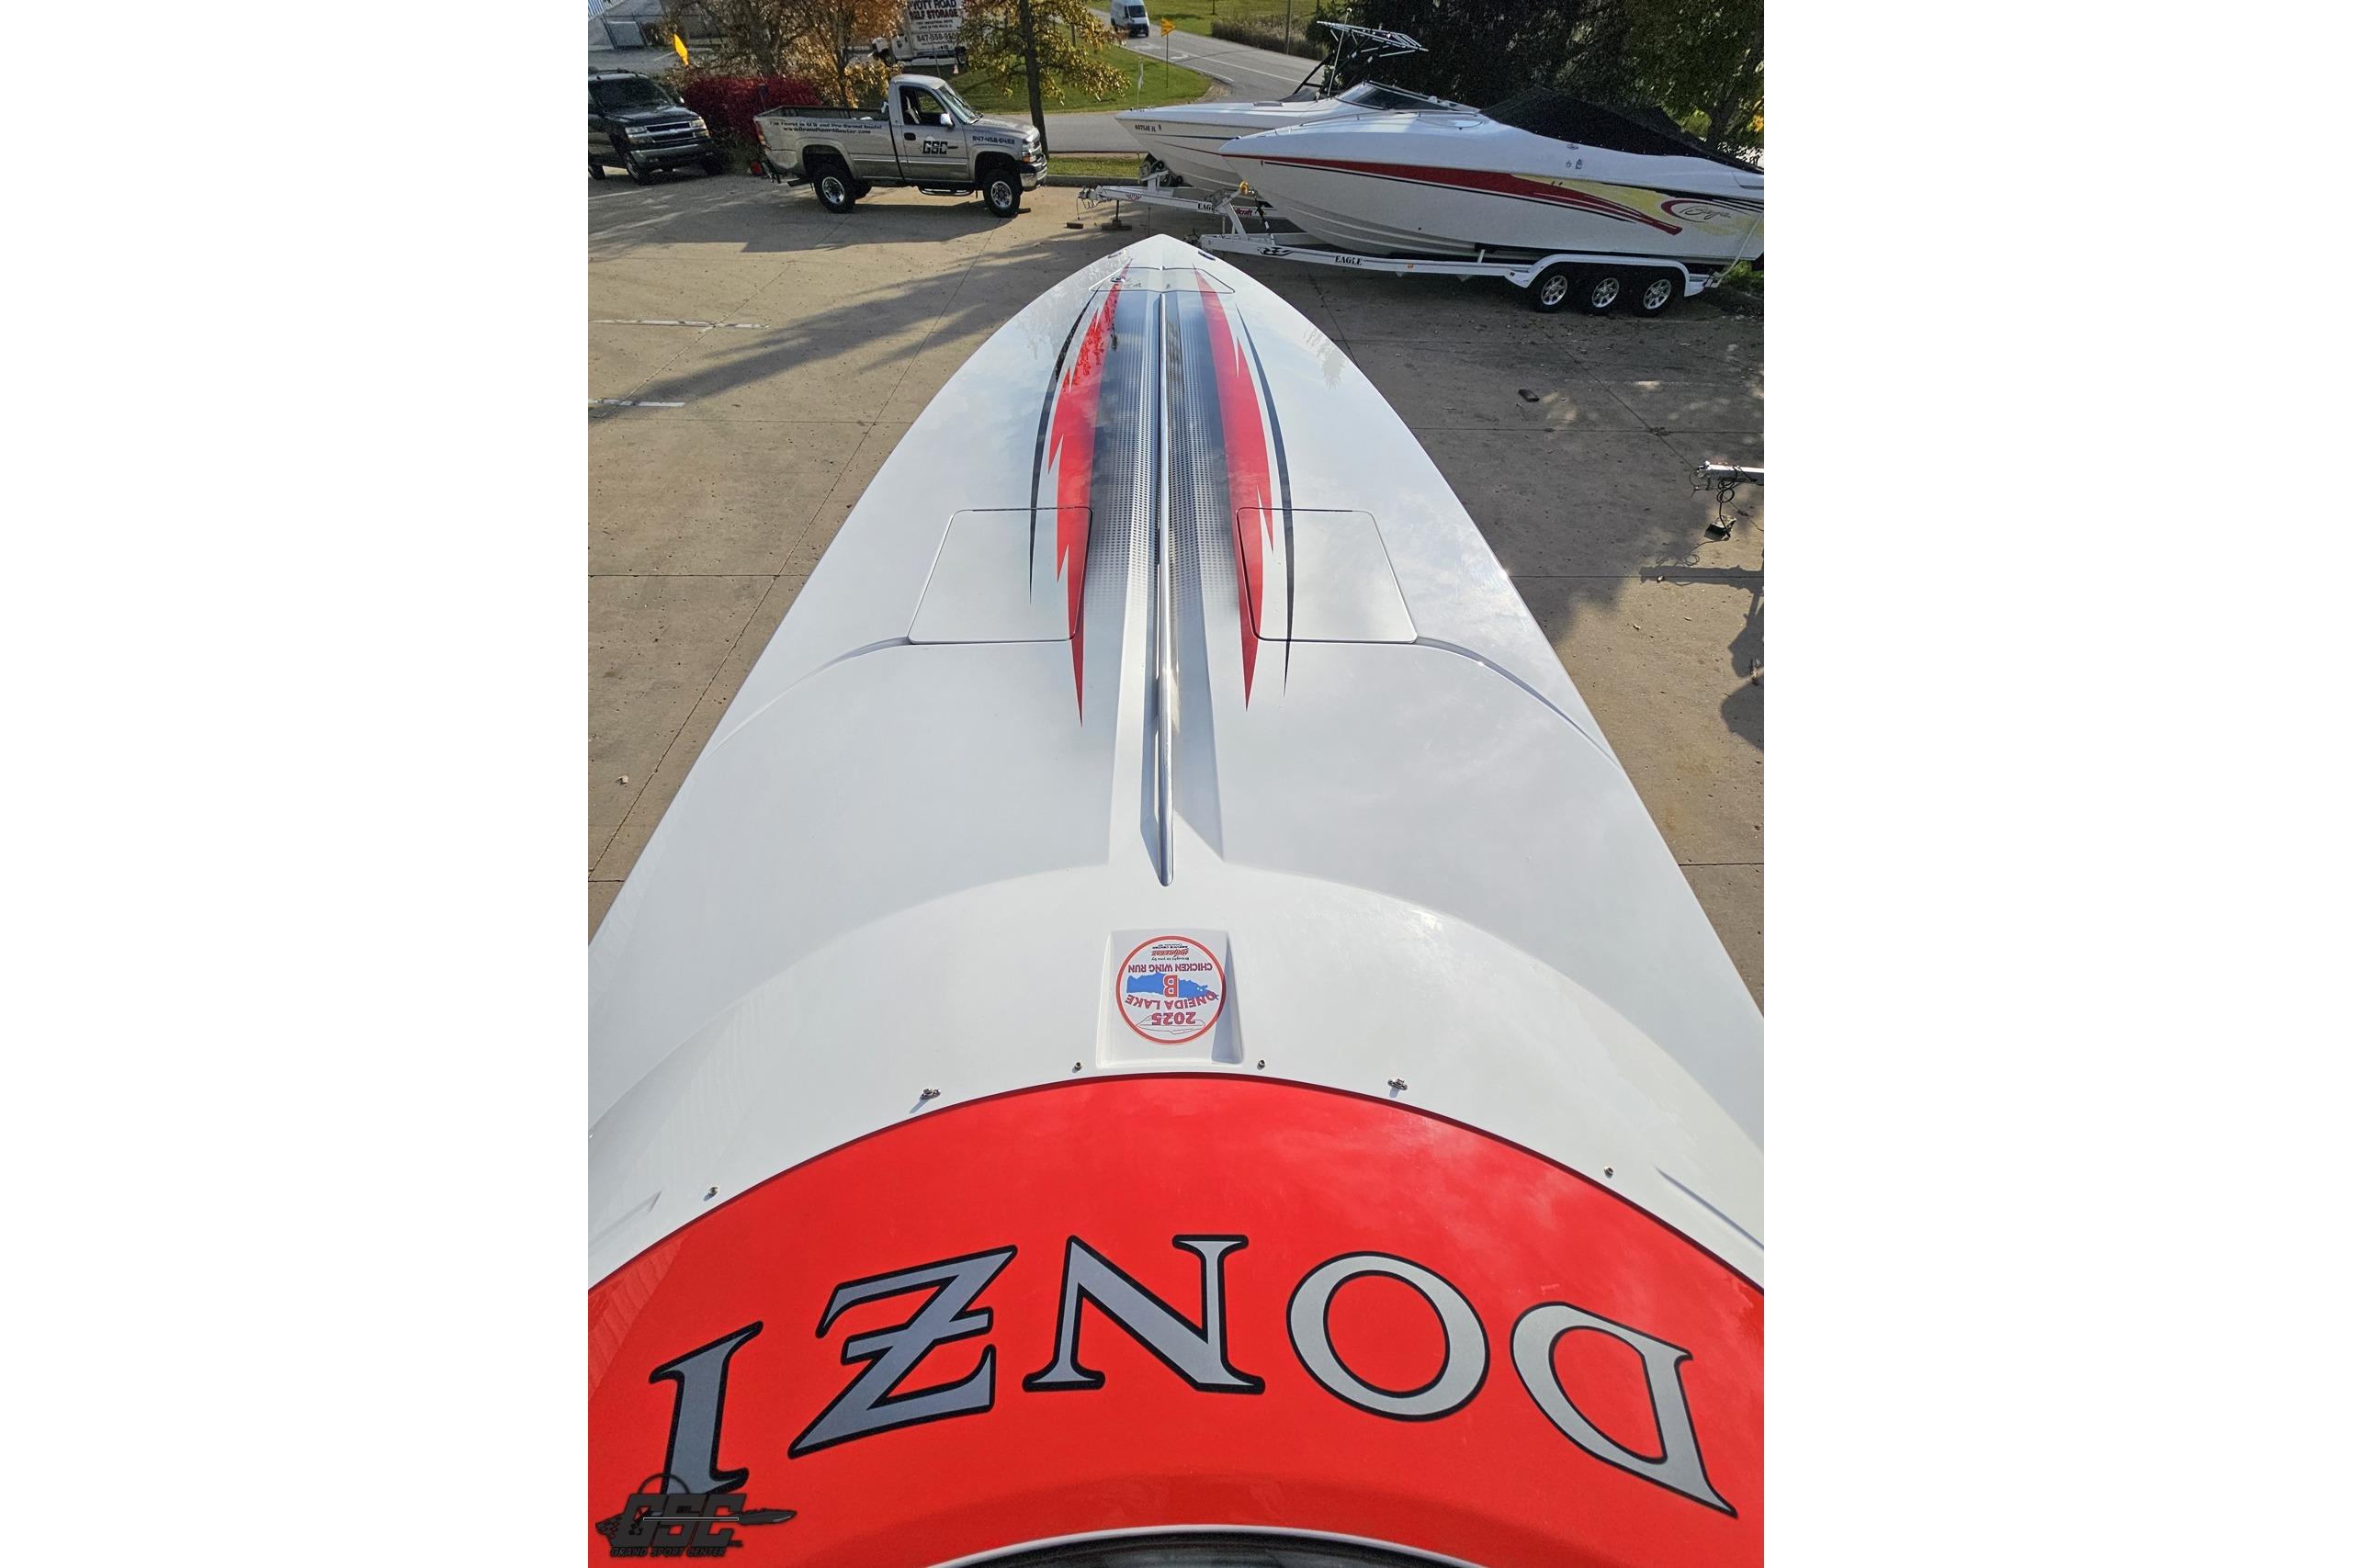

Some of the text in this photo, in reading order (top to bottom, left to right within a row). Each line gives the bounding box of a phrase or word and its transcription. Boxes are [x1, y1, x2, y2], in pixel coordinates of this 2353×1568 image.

[933, 0, 956, 9] ROAD
[926, 9, 957, 19] STORAGE
[922, 140, 949, 154] GSC
[1335, 255, 1363, 265] EAGLE
[1128, 962, 1213, 973] CHICKEN WING RUN
[1163, 974, 1178, 998] B
[1125, 991, 1216, 1010] ONEIDA LAKE
[1151, 1011, 1196, 1026] 2025
[649, 1234, 1736, 1518] DONZI
